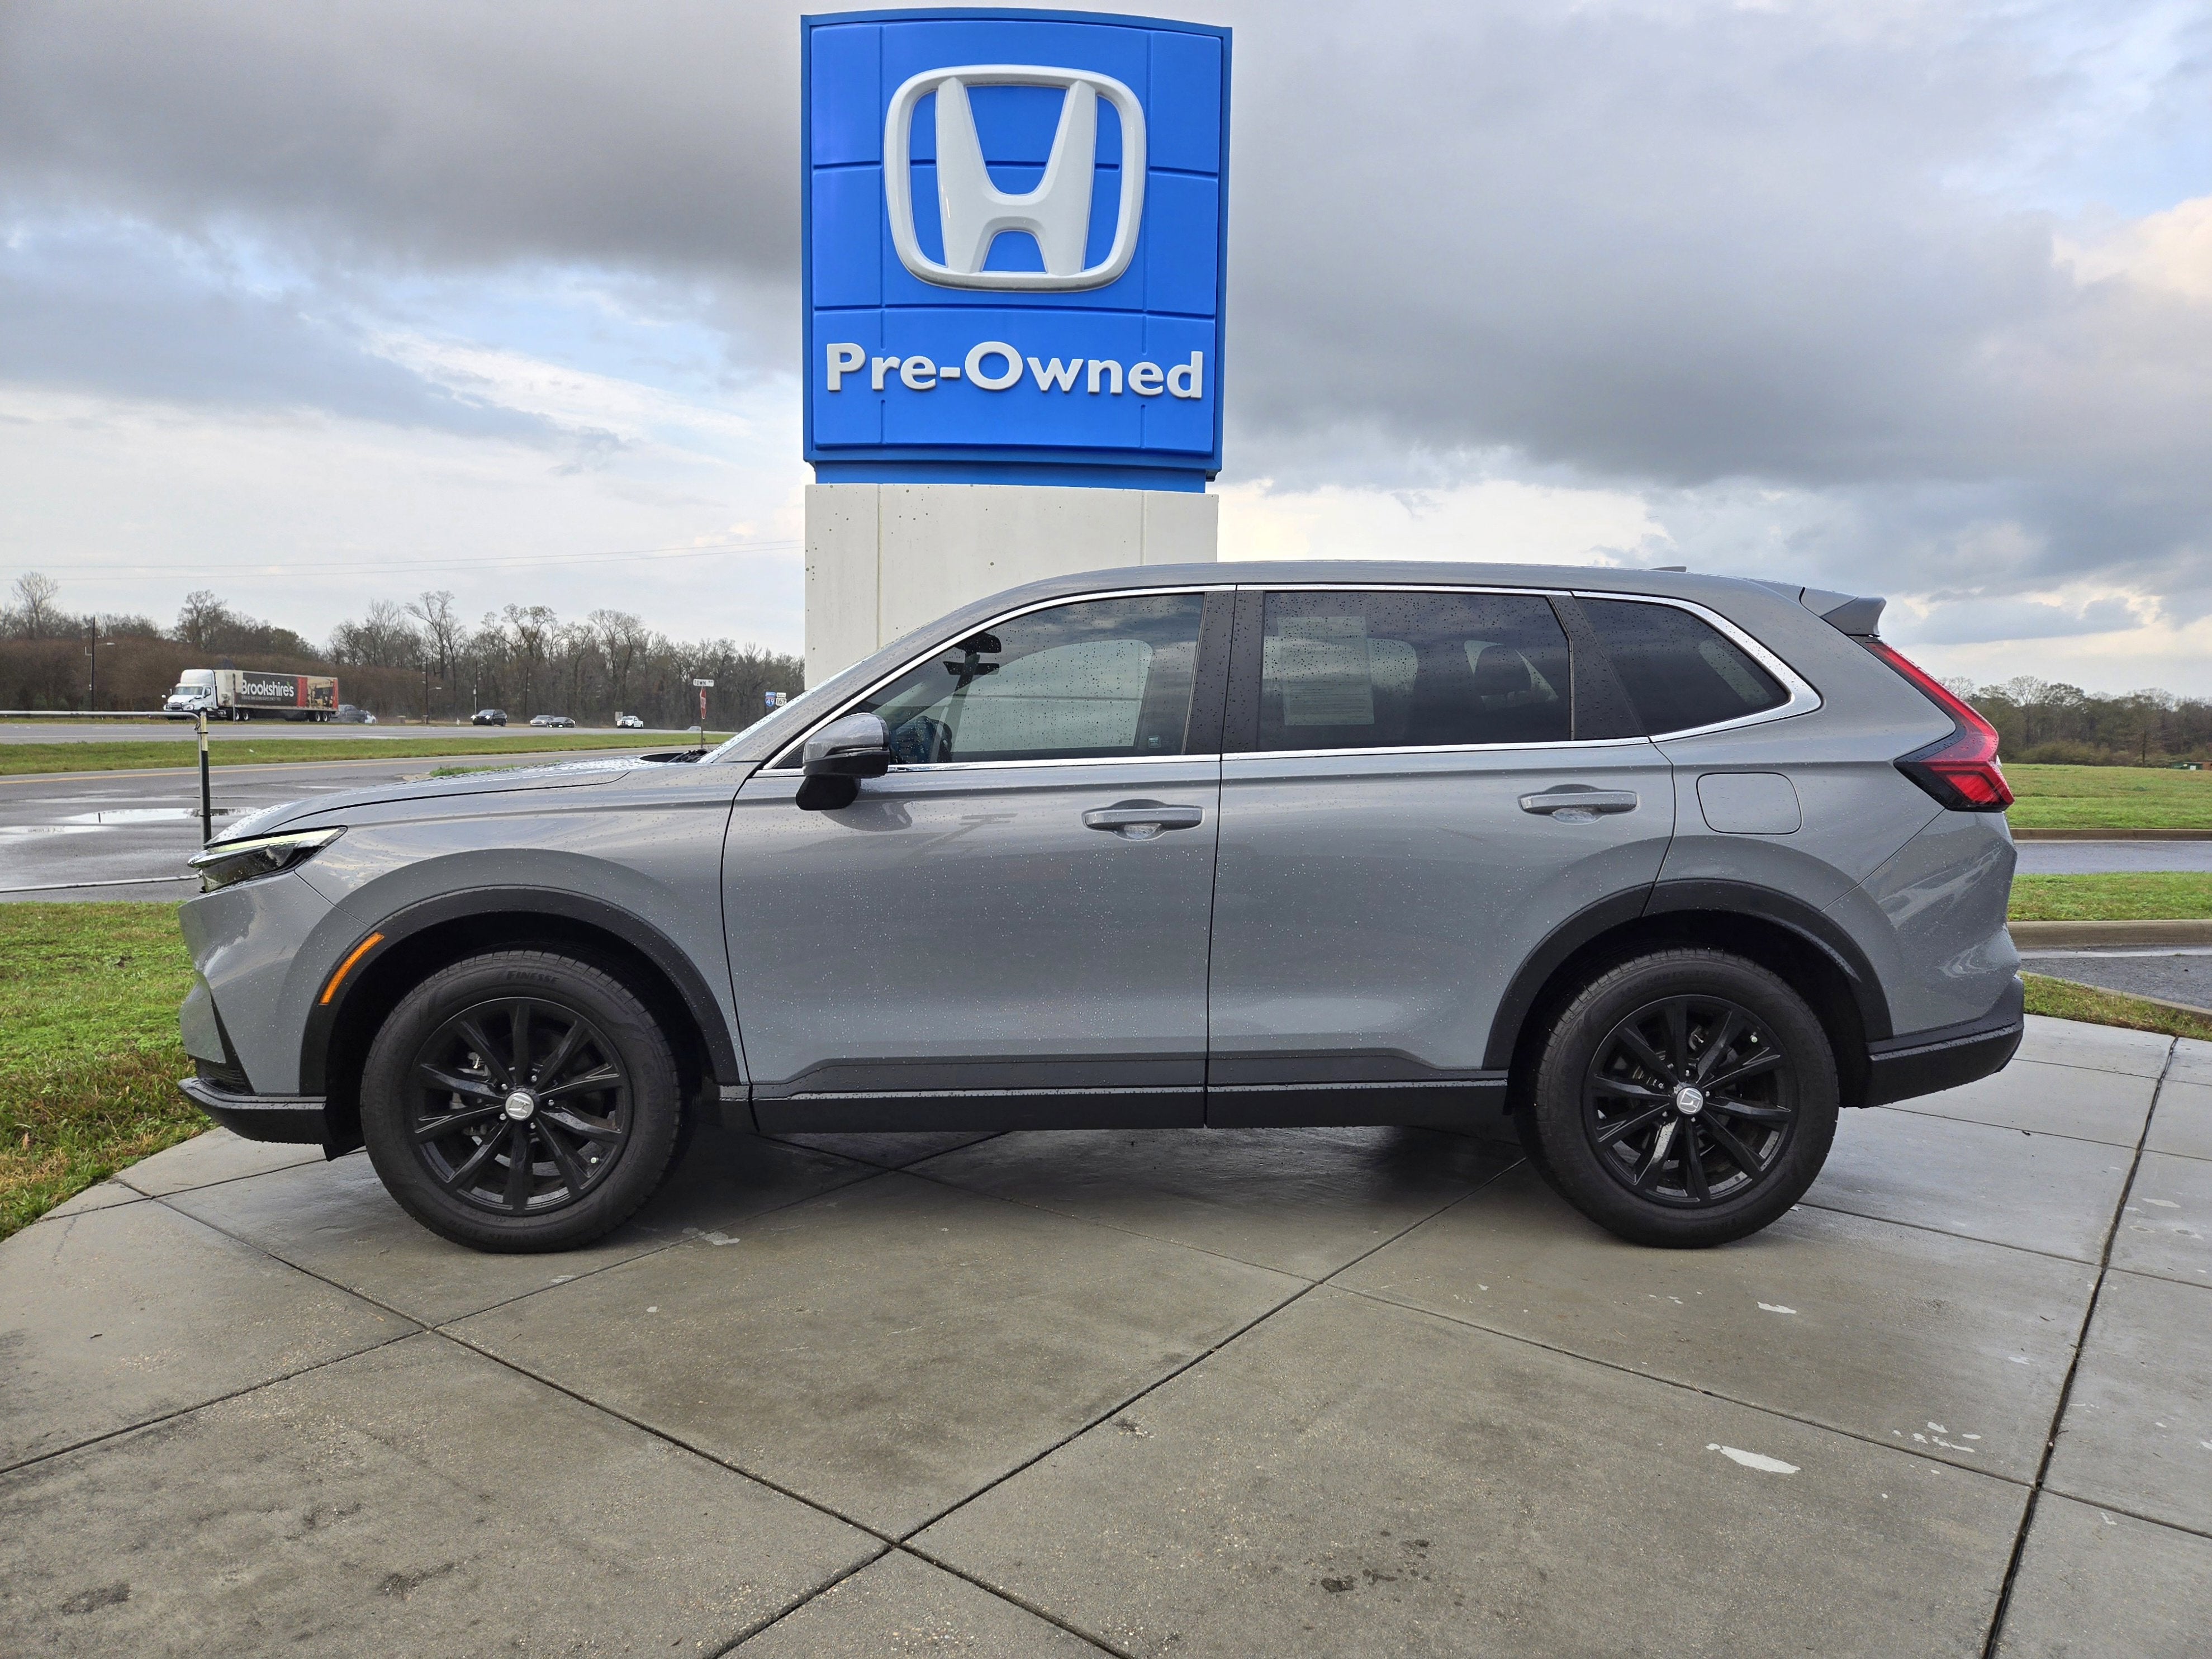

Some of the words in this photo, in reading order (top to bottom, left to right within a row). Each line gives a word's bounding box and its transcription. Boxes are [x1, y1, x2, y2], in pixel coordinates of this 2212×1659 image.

[827, 341, 1203, 399] Pre-Owned
[241, 679, 295, 697] Brookshire's
[506, 970, 560, 984] FINESSE
